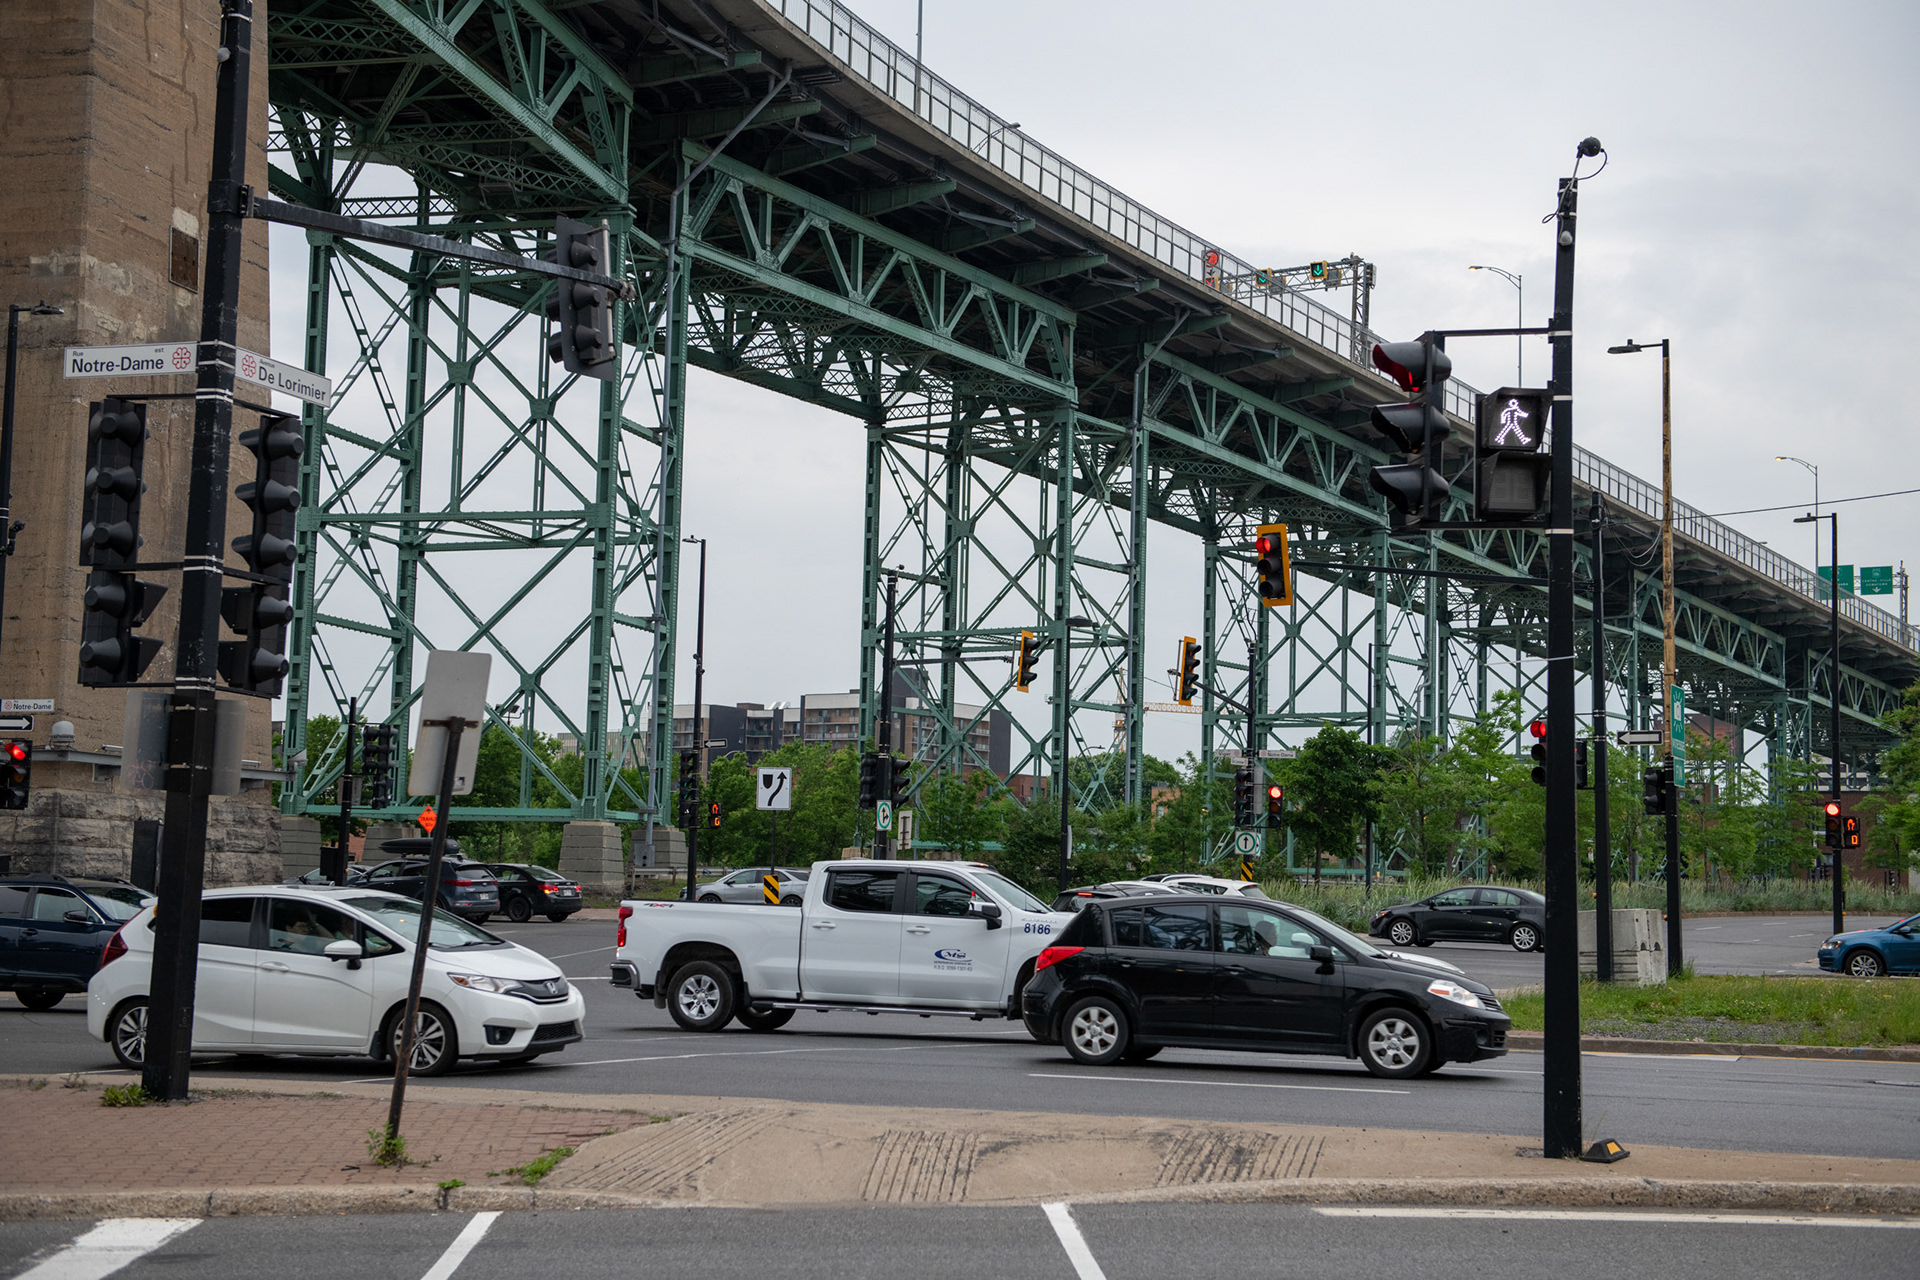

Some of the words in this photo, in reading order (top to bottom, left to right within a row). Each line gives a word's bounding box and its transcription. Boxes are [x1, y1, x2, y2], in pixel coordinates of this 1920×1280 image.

[72, 357, 164, 373] Notre-Dame
[258, 366, 275, 384] De
[278, 372, 326, 401] Lorimier
[1024, 922, 1051, 935] 8186
